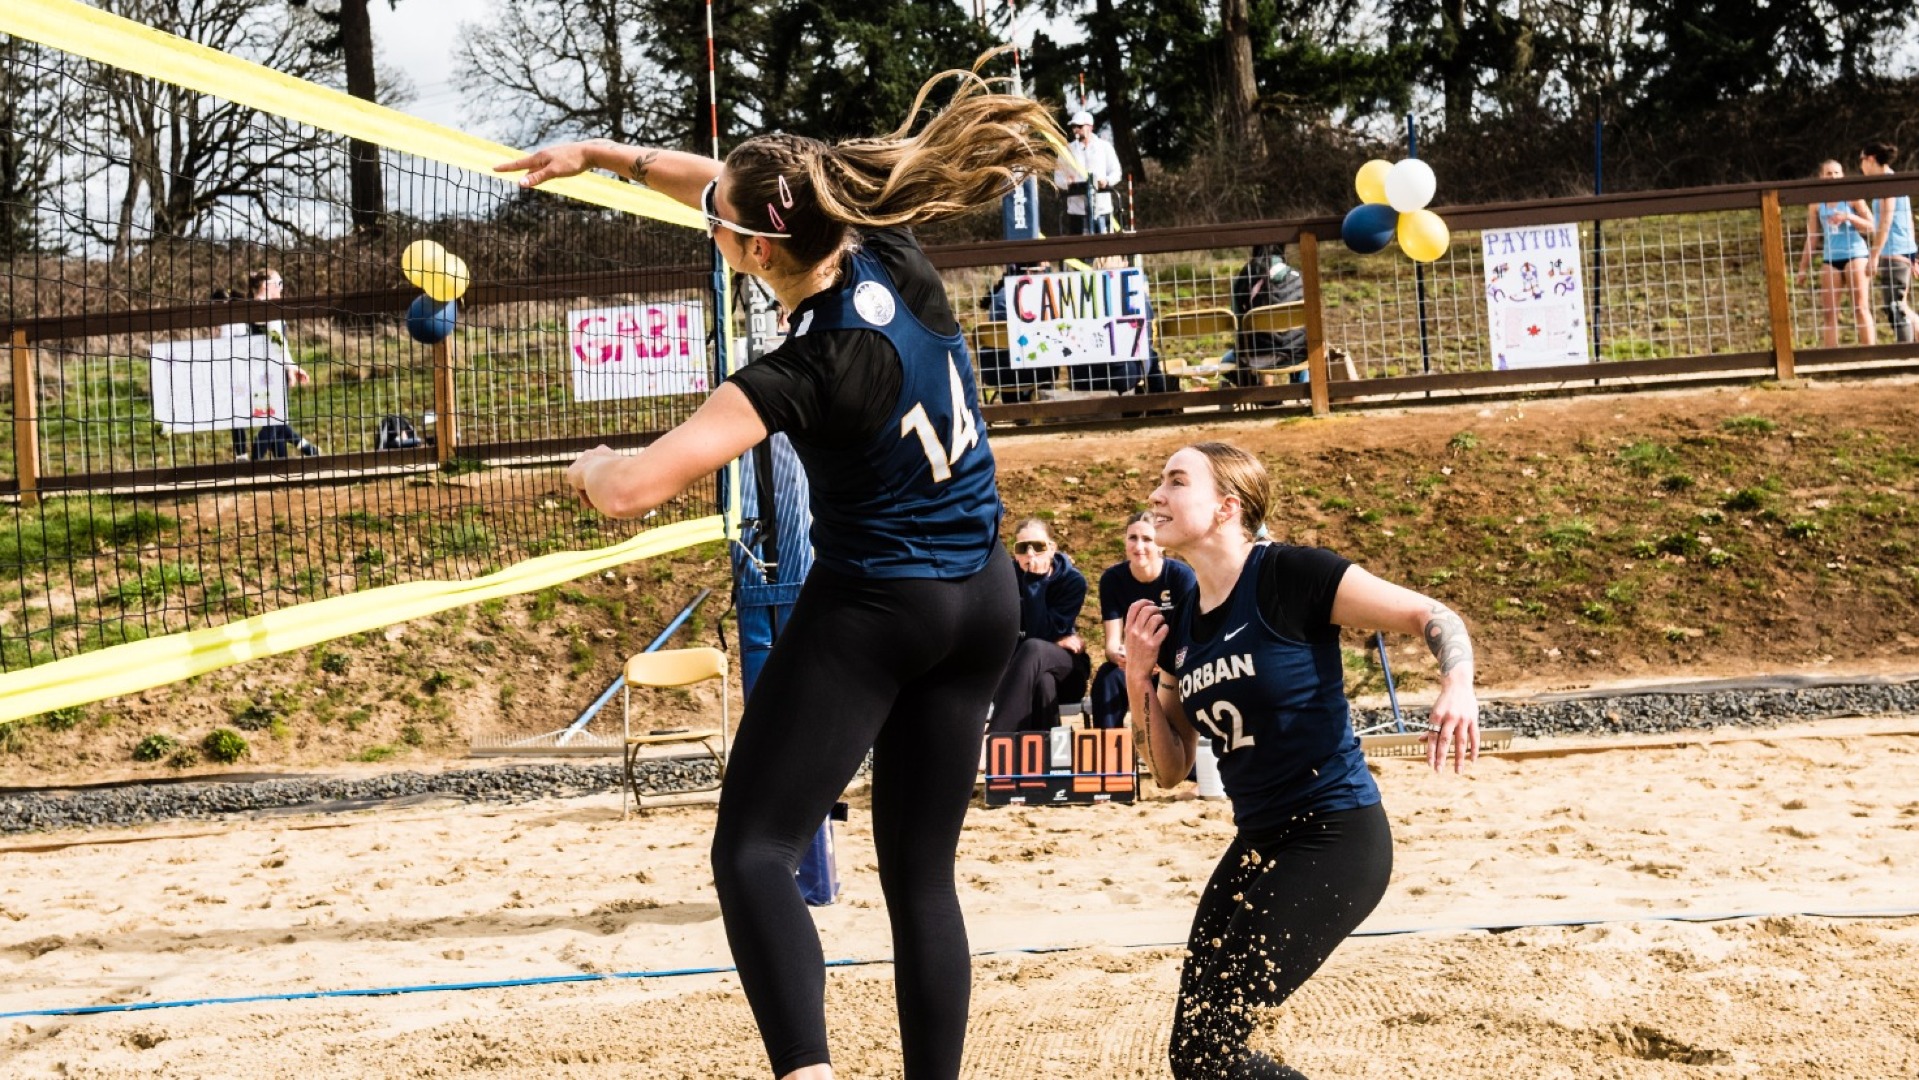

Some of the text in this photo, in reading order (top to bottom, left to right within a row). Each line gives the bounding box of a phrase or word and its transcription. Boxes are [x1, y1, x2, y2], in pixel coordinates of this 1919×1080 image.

[1485, 227, 1571, 256] PAYTON
[1013, 269, 1141, 323] CAMMIE
[574, 305, 689, 365] GABI
[1103, 318, 1145, 357] 17
[901, 350, 979, 483] 14
[1053, 732, 1068, 759] 2
[1195, 700, 1255, 753] 12
